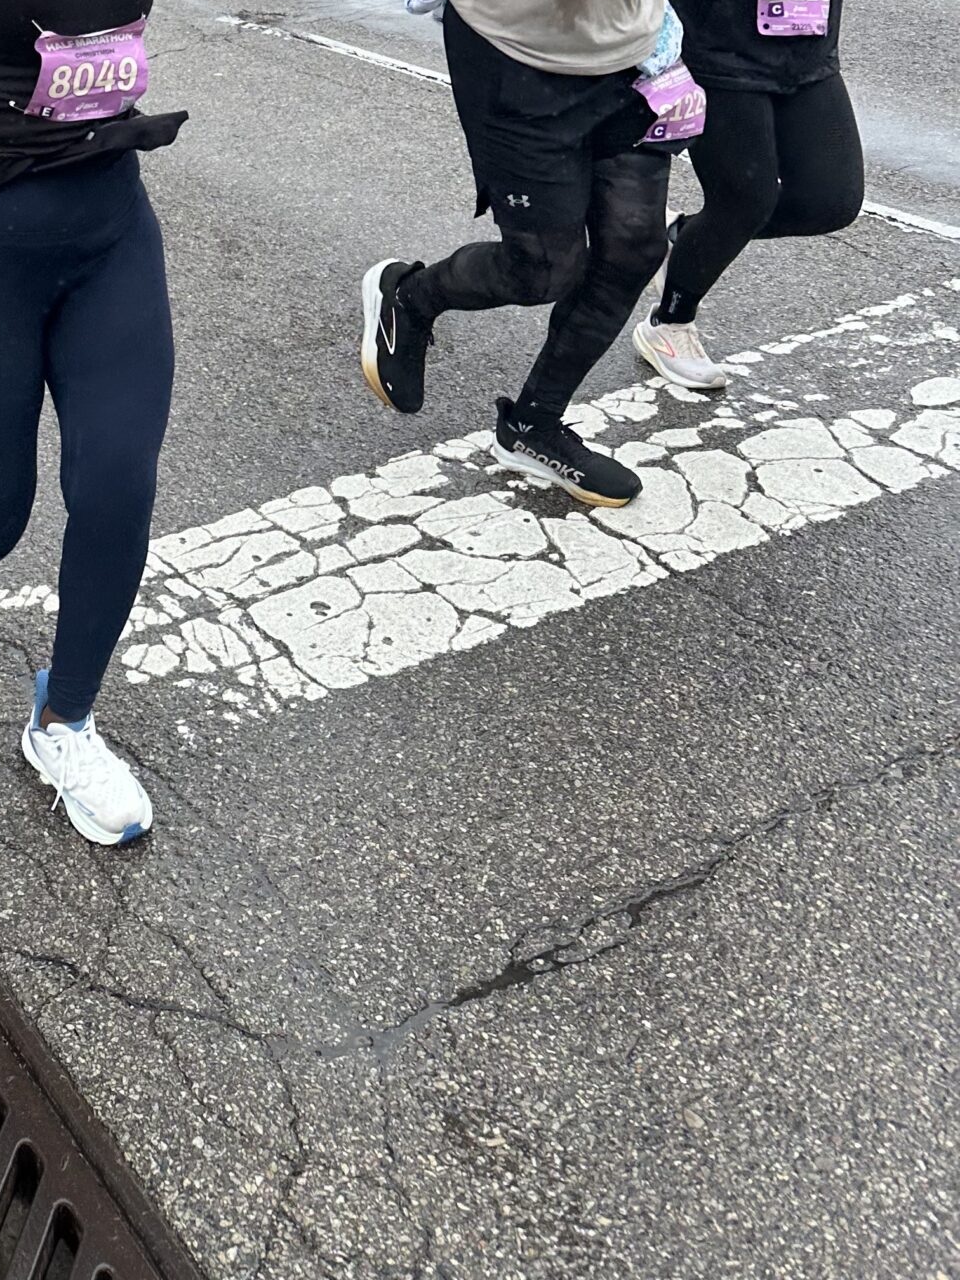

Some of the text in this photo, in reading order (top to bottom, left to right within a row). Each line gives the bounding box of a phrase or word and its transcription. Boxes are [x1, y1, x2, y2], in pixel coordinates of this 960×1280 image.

[771, 4, 782, 15] C
[45, 32, 134, 51] HALF MARATHON
[48, 56, 138, 99] 8049
[41, 107, 52, 117] E
[654, 126, 665, 136] C
[512, 440, 586, 484] BROOKS
